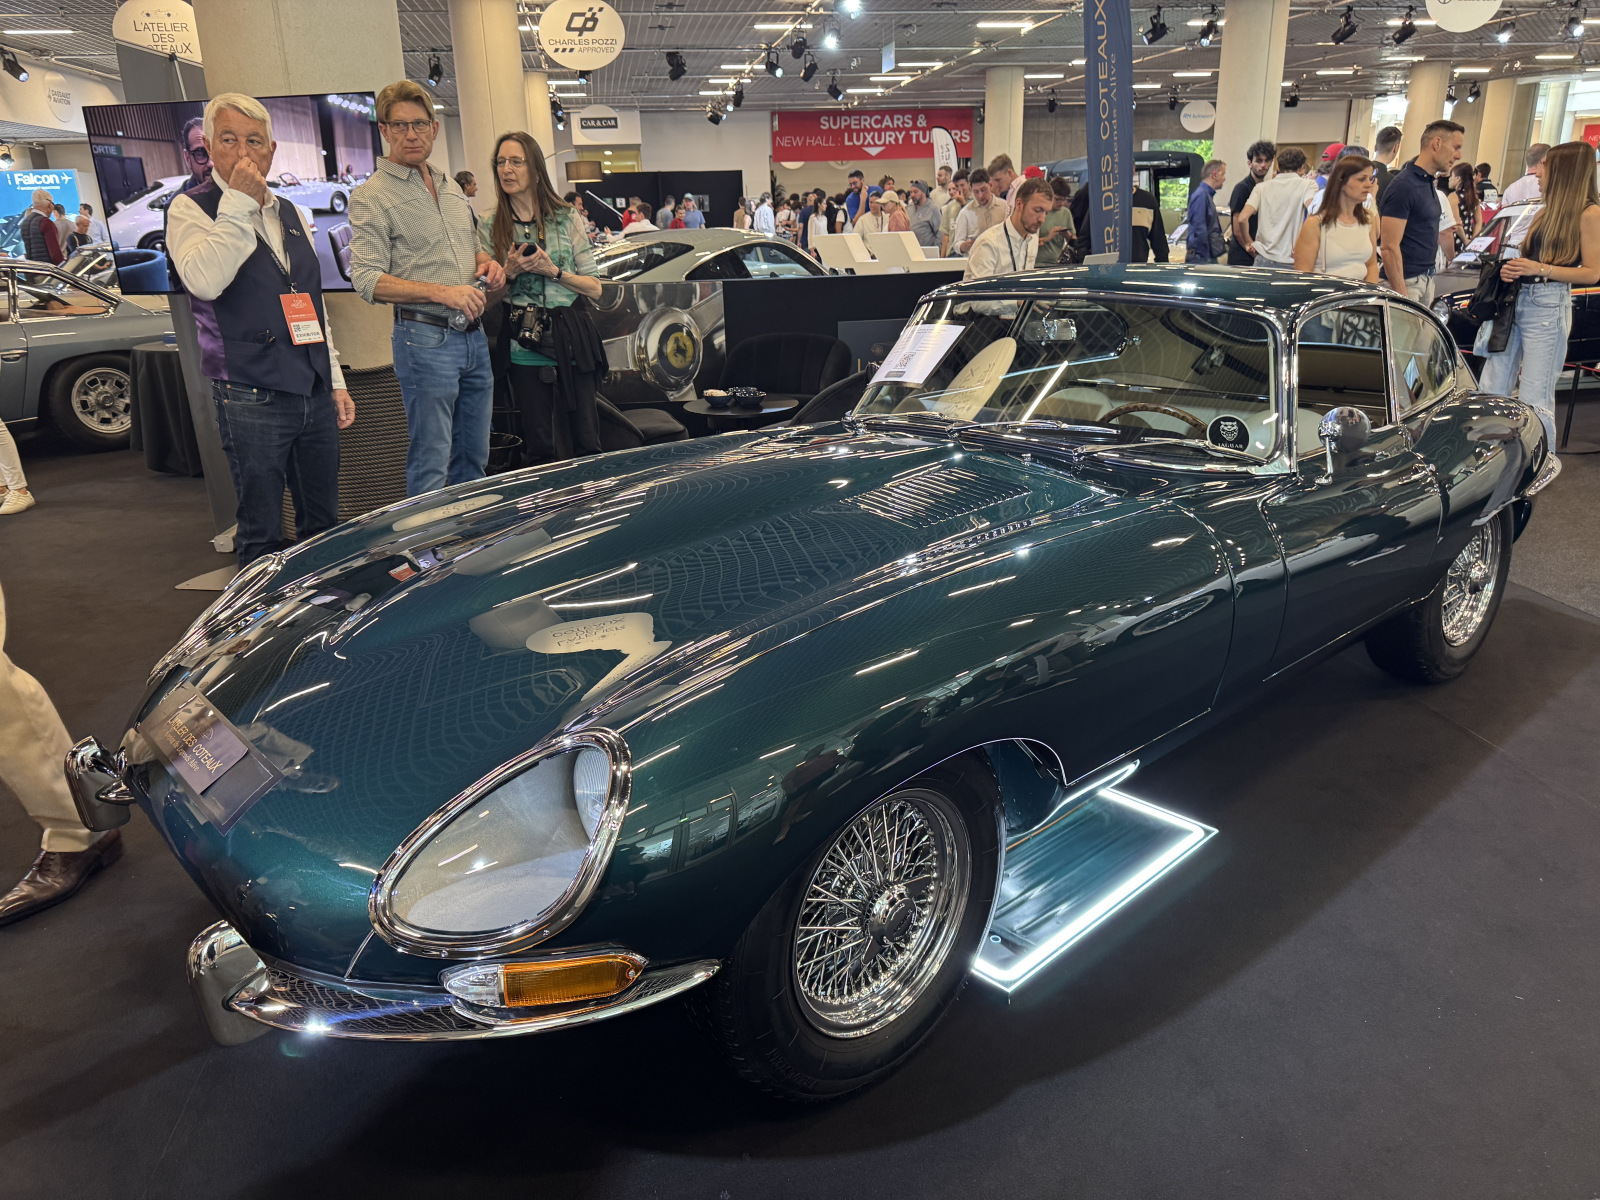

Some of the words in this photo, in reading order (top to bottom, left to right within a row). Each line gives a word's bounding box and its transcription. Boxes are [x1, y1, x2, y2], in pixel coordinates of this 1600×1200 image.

[133, 20, 190, 33] L'ATELIER
[151, 33, 176, 43] DES
[548, 38, 590, 46] CHARLES
[591, 38, 618, 46] POZZI
[578, 46, 616, 54] APPROVED
[1094, 0, 1110, 140] COTEAUX
[820, 114, 913, 130] SUPERCARS
[916, 113, 927, 128] &
[775, 135, 804, 147] NEW
[806, 135, 836, 147] HALL
[844, 130, 906, 146] LUXURY
[909, 129, 971, 145] TURS
[13, 172, 60, 185] Falcon
[1101, 154, 1114, 212] DES
[183, 732, 198, 748] DES
[192, 743, 224, 774] COTEAUX
